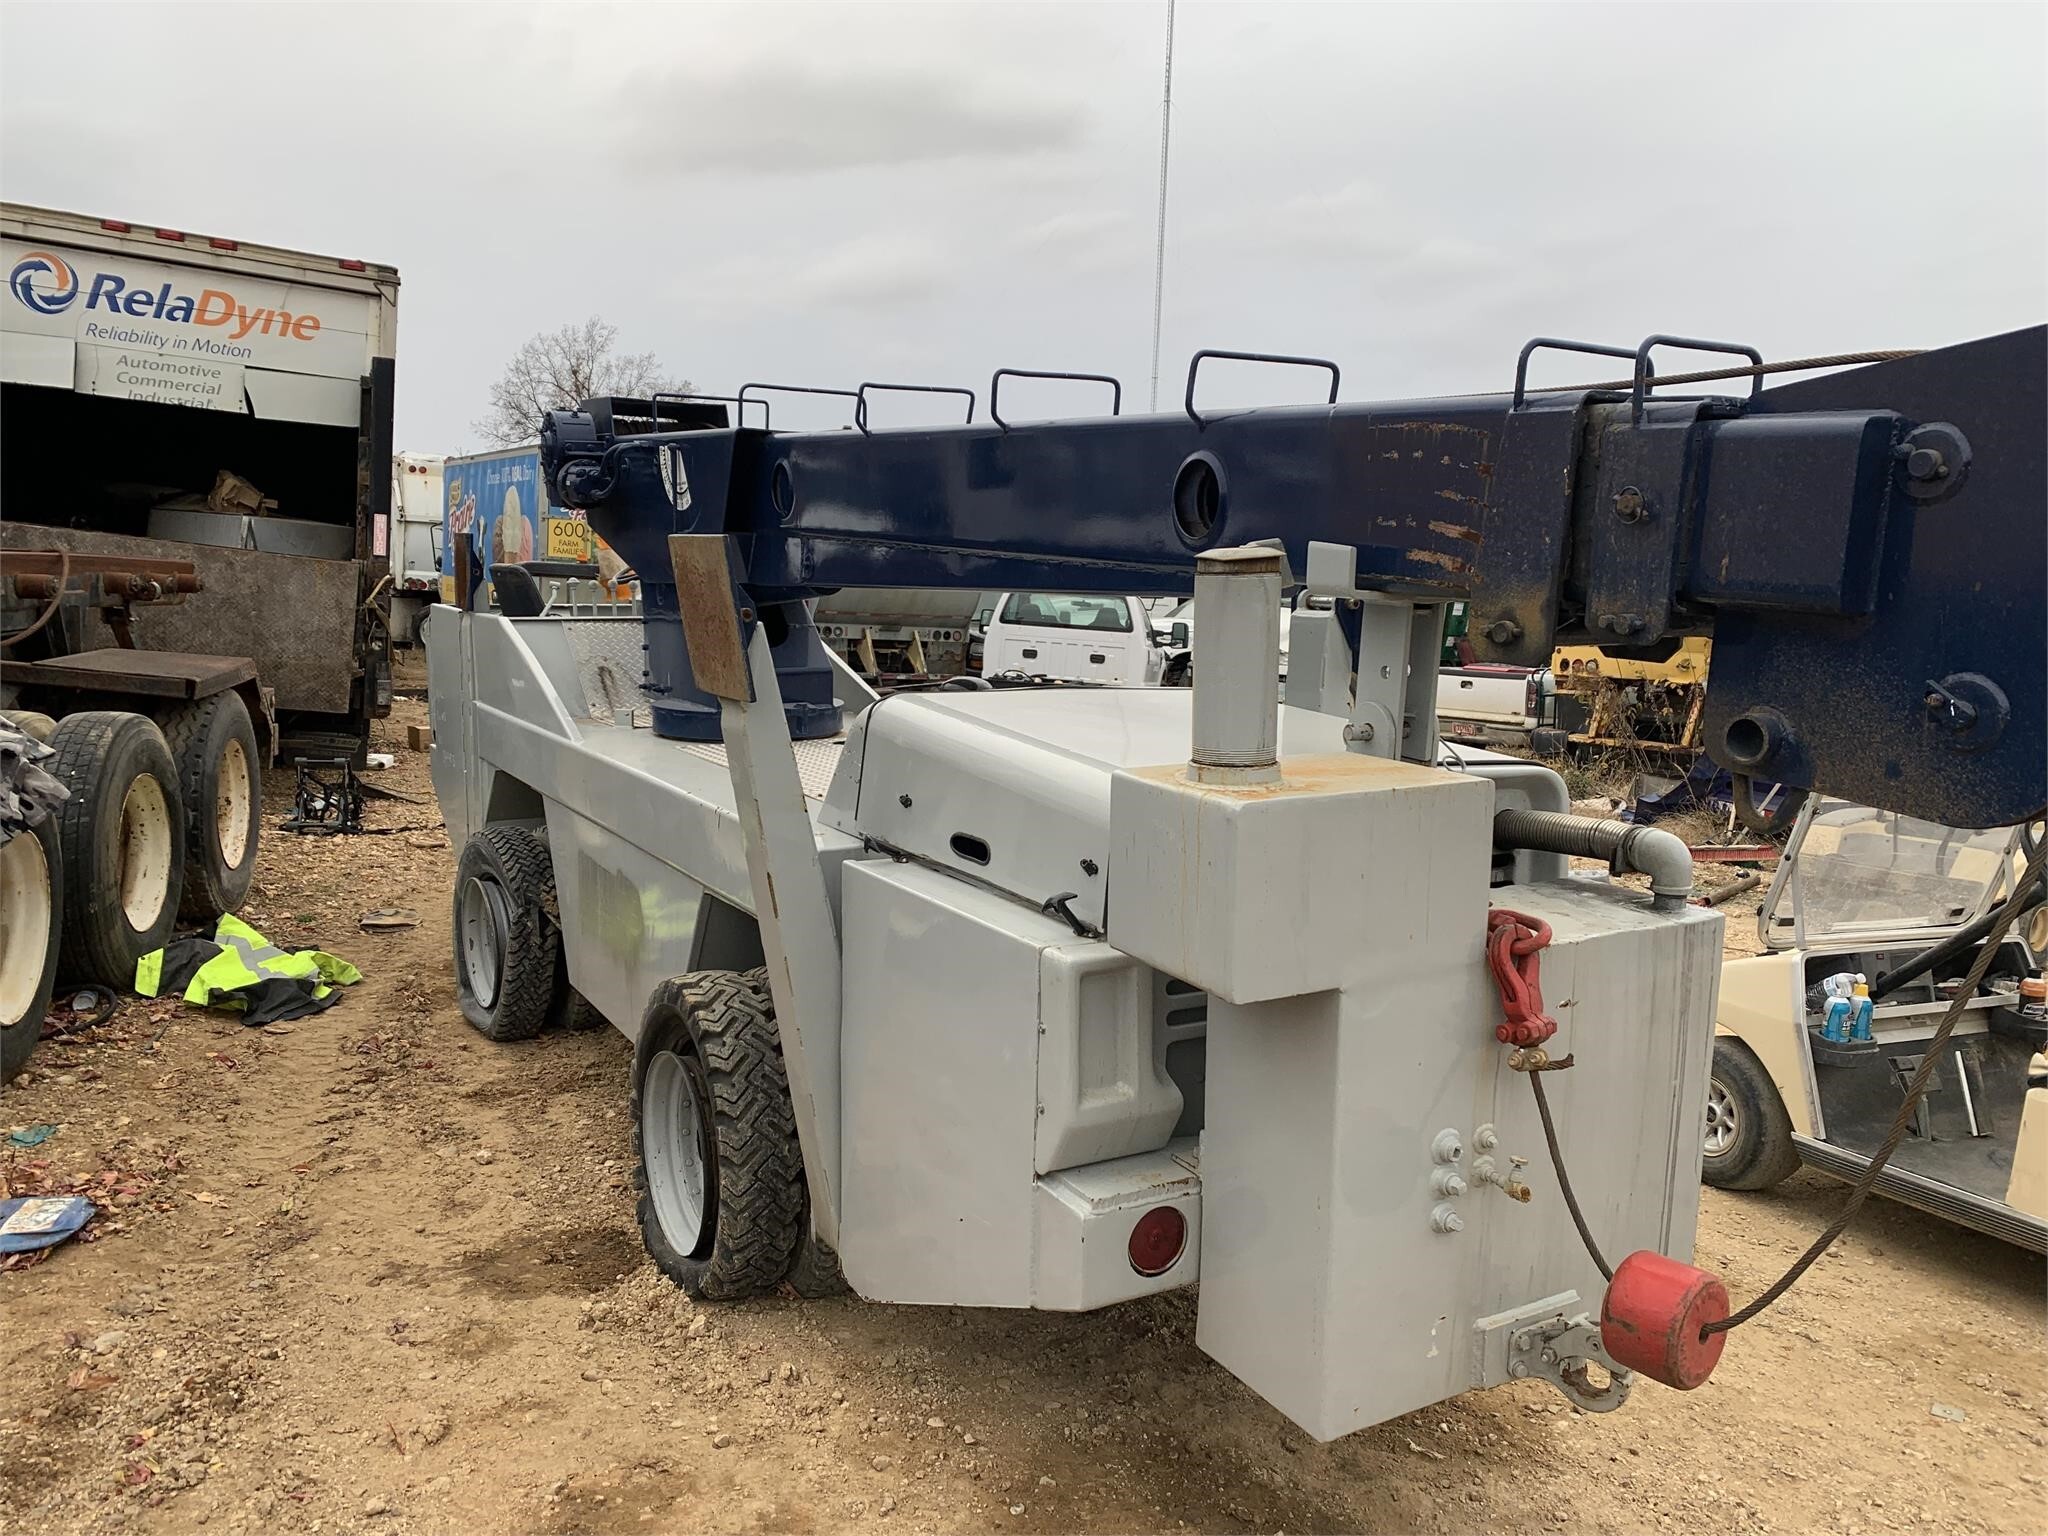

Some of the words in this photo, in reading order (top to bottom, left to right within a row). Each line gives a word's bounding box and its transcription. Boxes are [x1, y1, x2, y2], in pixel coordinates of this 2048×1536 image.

[85, 272, 321, 341] RelaDyne
[86, 322, 168, 350] Reliability
[173, 334, 188, 349] in
[191, 338, 252, 359] Motion
[116, 354, 222, 379] Automotive
[116, 371, 222, 395] Commercial
[553, 522, 585, 538] 600
[552, 546, 586, 555] FAMILIES
[558, 539, 579, 548] FARM
